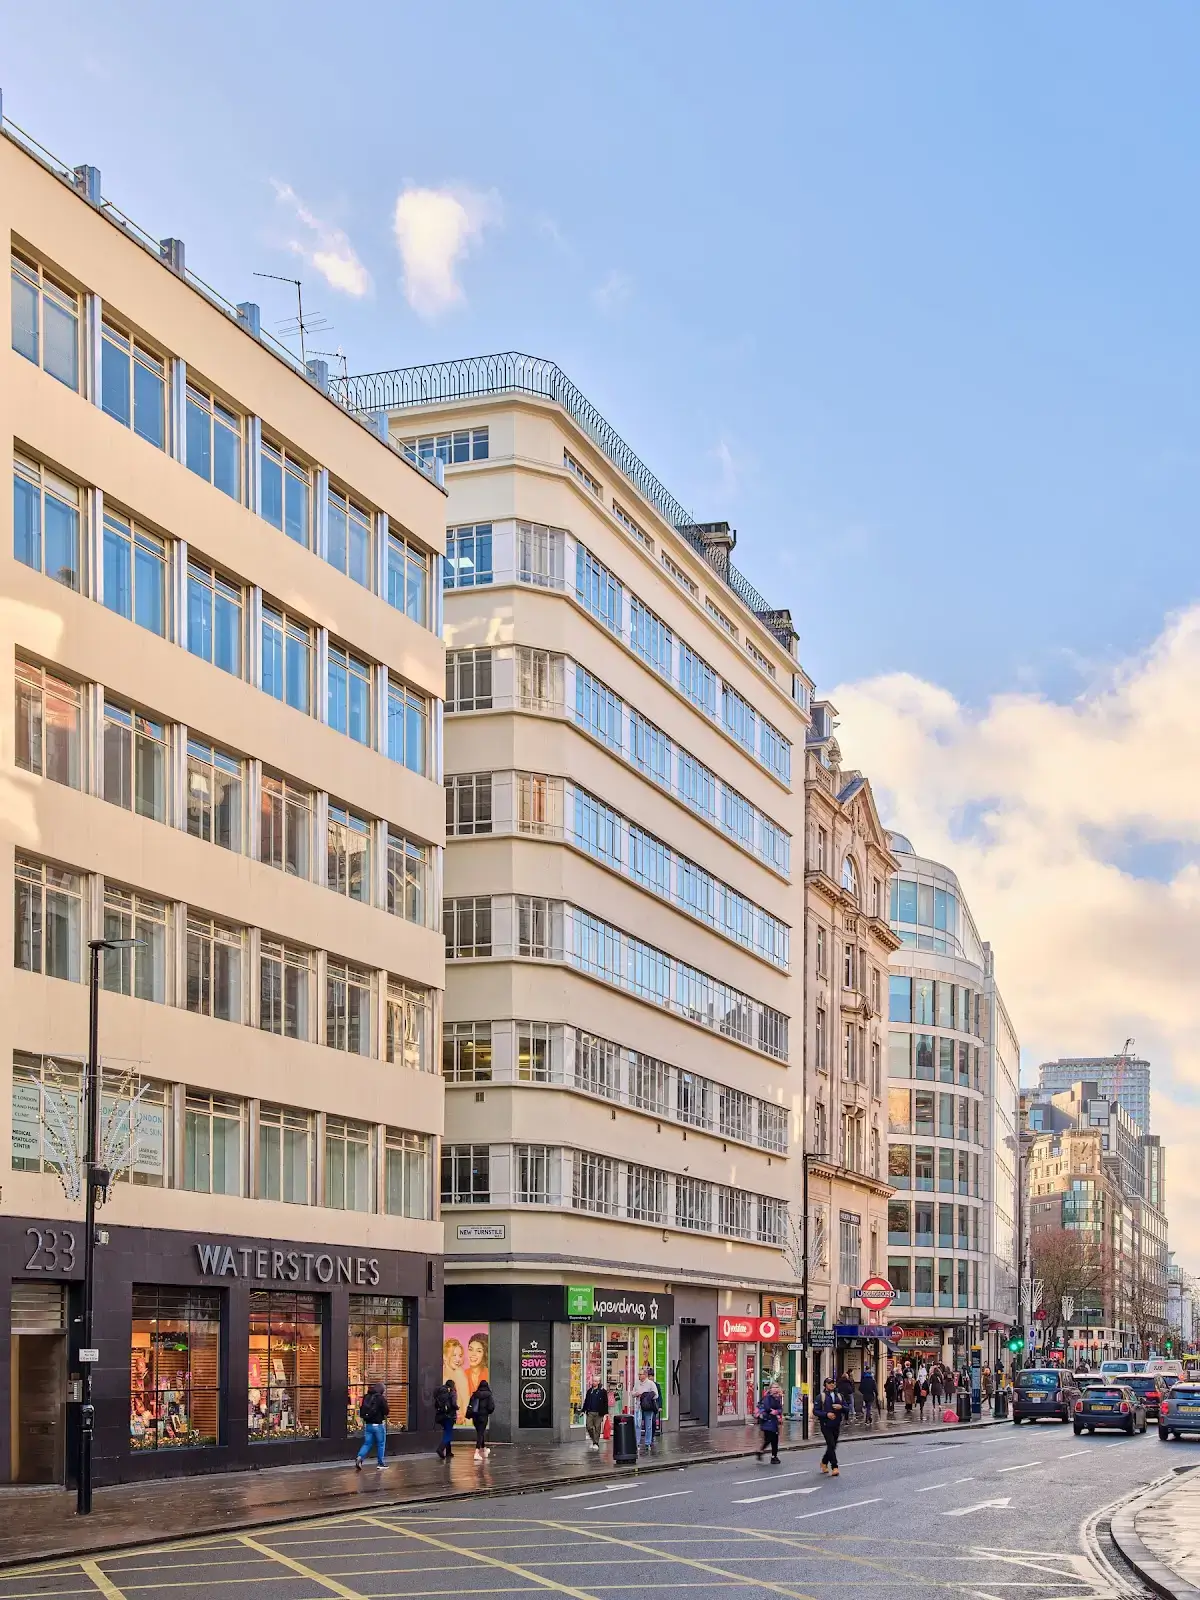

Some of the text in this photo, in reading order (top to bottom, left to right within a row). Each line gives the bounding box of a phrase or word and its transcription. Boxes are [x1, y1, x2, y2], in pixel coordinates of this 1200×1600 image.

[12, 1129, 32, 1137] MEDICAL
[25, 1227, 76, 1272] 233
[197, 1243, 380, 1287] WATERSTONES
[857, 1289, 896, 1299] UNDERGROUND
[592, 1297, 647, 1321] uperdrug
[915, 1337, 934, 1346] Local
[521, 1358, 547, 1368] save
[521, 1367, 547, 1377] more
